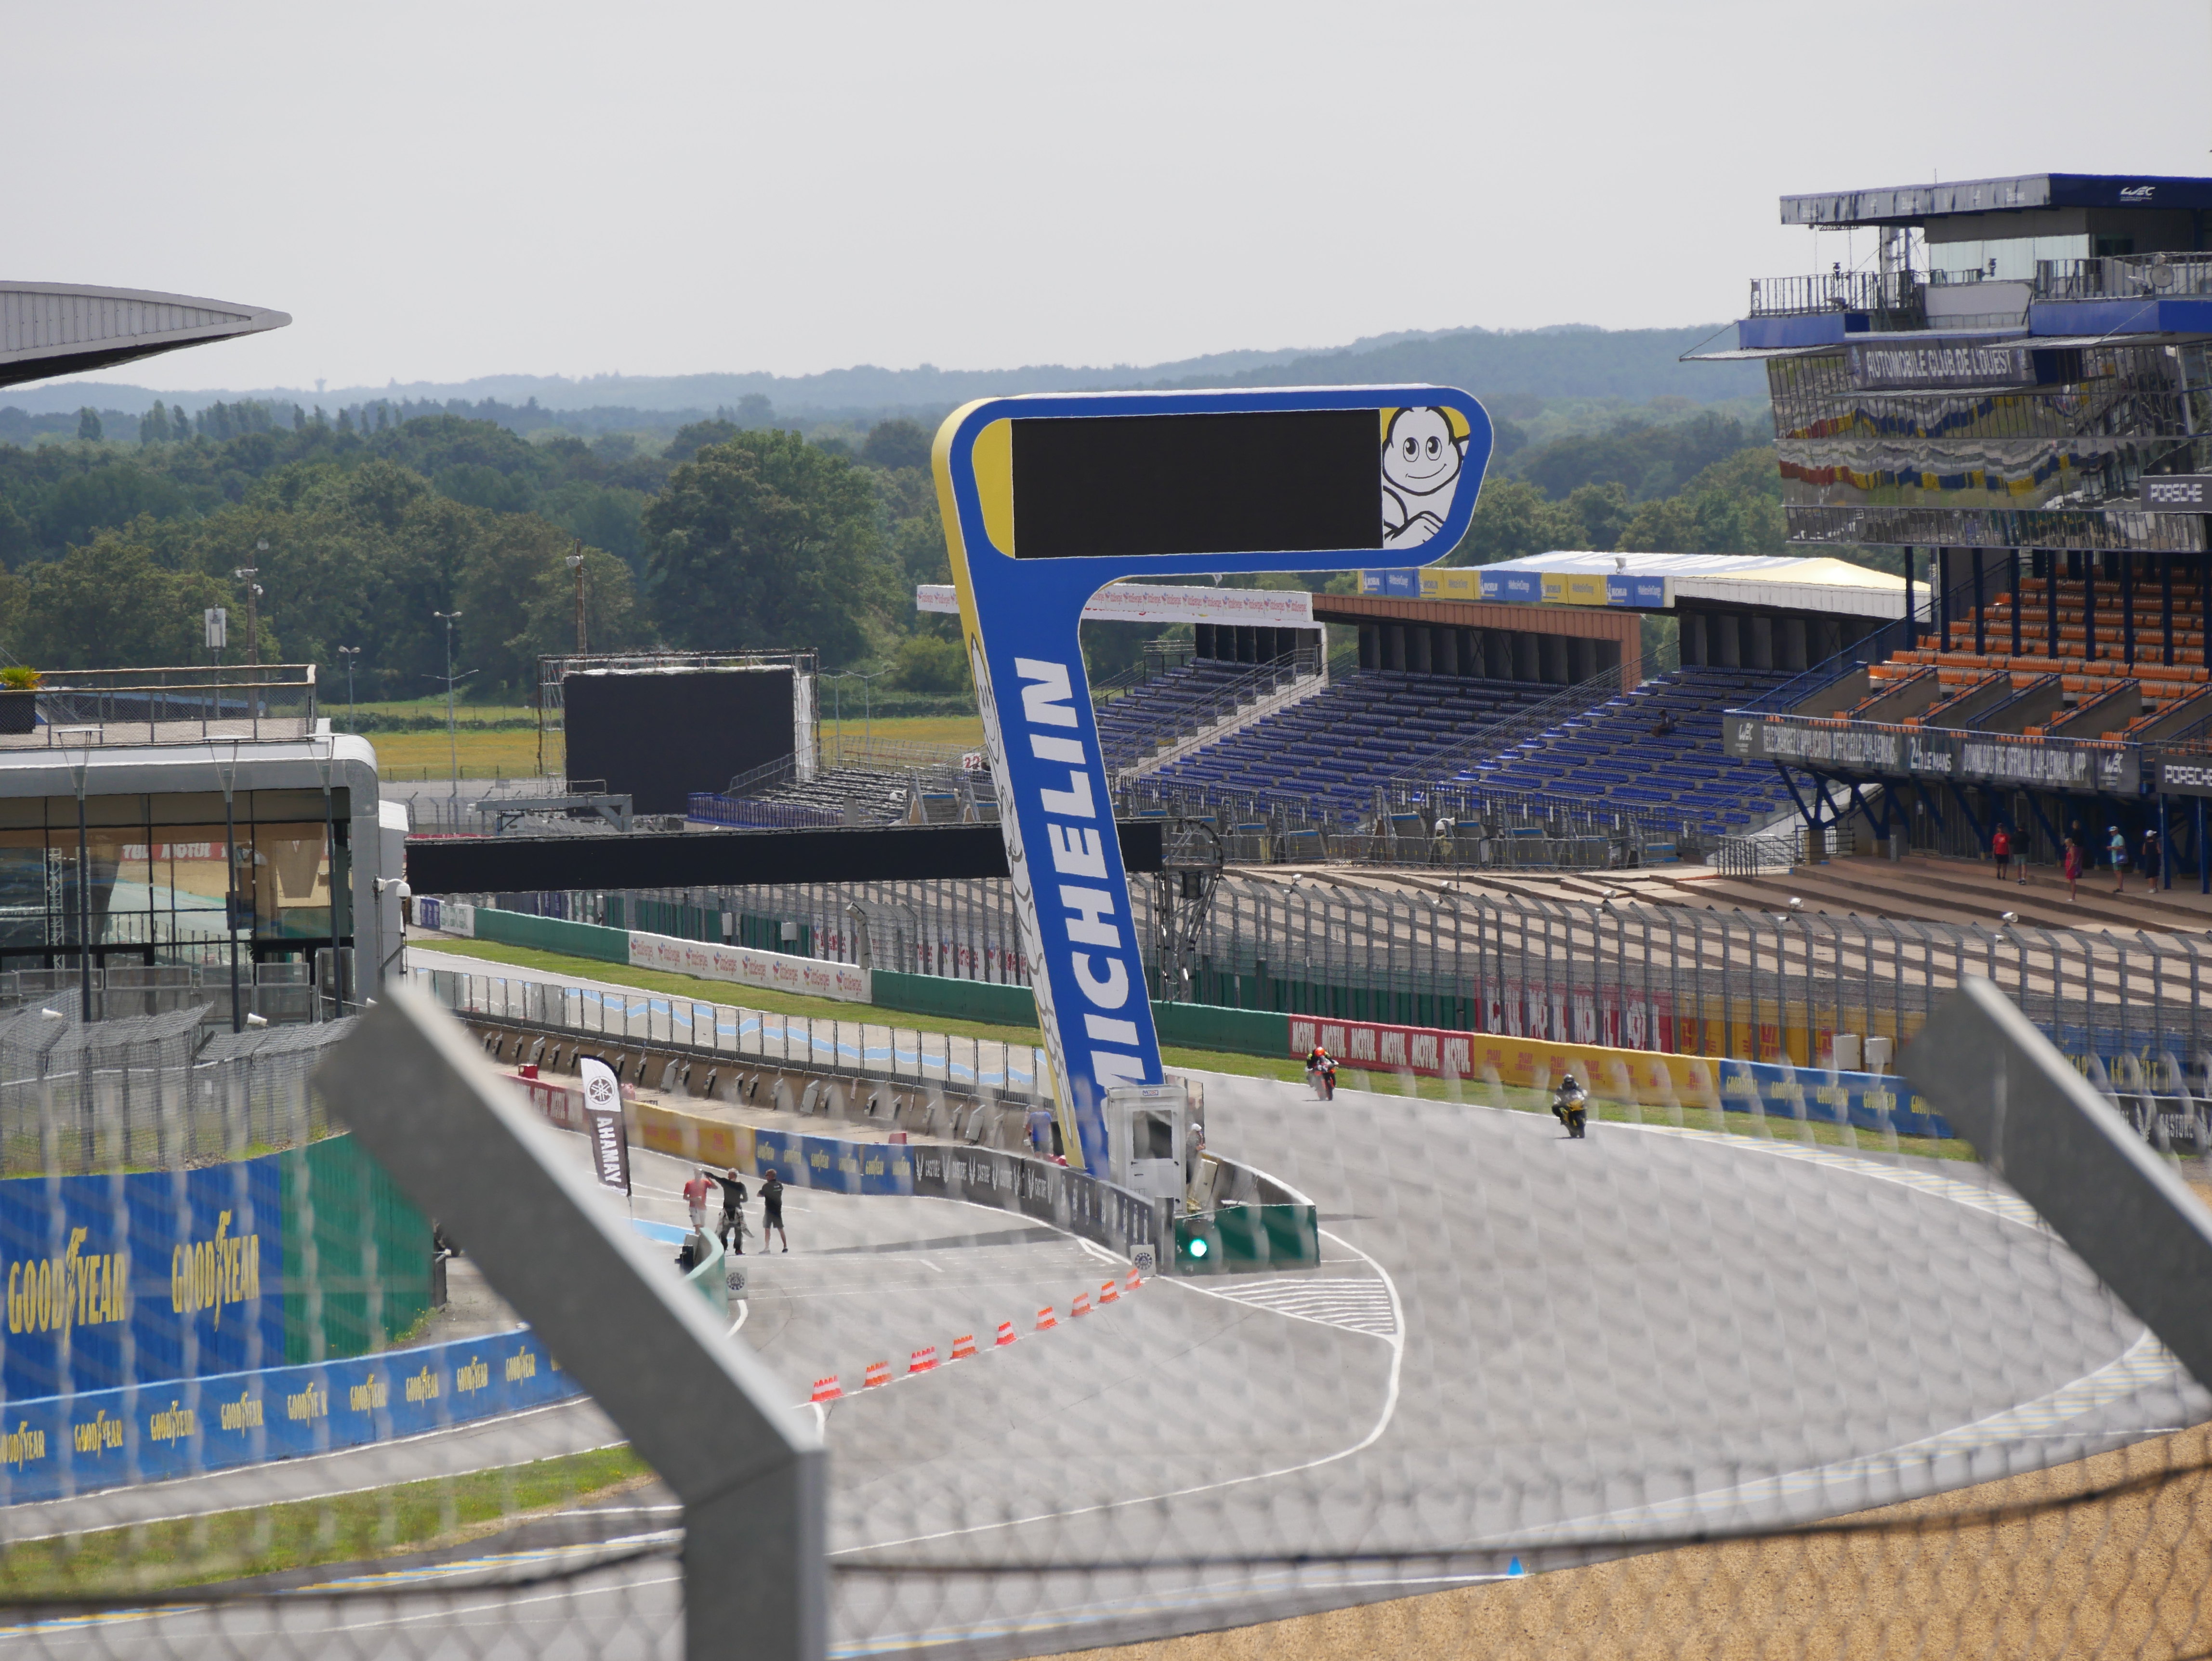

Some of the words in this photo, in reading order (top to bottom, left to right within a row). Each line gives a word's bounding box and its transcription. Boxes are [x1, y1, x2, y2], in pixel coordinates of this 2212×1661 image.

[2120, 186, 2156, 196] WEC
[1866, 350, 1927, 378] AUTOMOBILE
[1928, 349, 1955, 377] CLUB
[1955, 348, 1971, 376] DE
[1971, 348, 2012, 375] L'OUEST
[2150, 484, 2202, 502] PORSCHE
[1933, 752, 1951, 772] MANS
[1964, 743, 1994, 774] DOWNLOAD
[1995, 746, 2005, 775] THE
[2007, 747, 2031, 778] OFFICIAL
[2074, 752, 2086, 781] APP
[1292, 1021, 1317, 1054] MOTUL
[1322, 1024, 1346, 1058] MOTUL
[1351, 1028, 1376, 1061] MOTUL
[1381, 1031, 1407, 1066] MOTUL
[1412, 1034, 1438, 1069] MOTUL
[1444, 1038, 1471, 1073] MOTUL
[1726, 1076, 1758, 1095] GOODYEAR
[1772, 1081, 1803, 1100] GOODYEAR
[1817, 1086, 1849, 1106] GOODYEAR
[1863, 1091, 1897, 1110] GOODYEAR
[925, 1160, 940, 1177] CASTORE
[977, 1163, 990, 1183] CASTORE
[171, 1234, 259, 1313] GOODYEAR
[8, 1253, 126, 1334] GOODYEAR
[457, 1362, 488, 1392] GOODYEAR
[506, 1354, 536, 1382] GOODYEAR
[350, 1383, 387, 1411] GOODYEAR
[406, 1373, 439, 1402] GOODYEAR
[221, 1400, 263, 1430] GOODYEAR
[288, 1391, 328, 1420] GOODYER
[75, 1420, 123, 1452] GOODYEAR
[150, 1409, 194, 1441] GOODYEAR
[0, 1430, 45, 1463] OODYEAR
